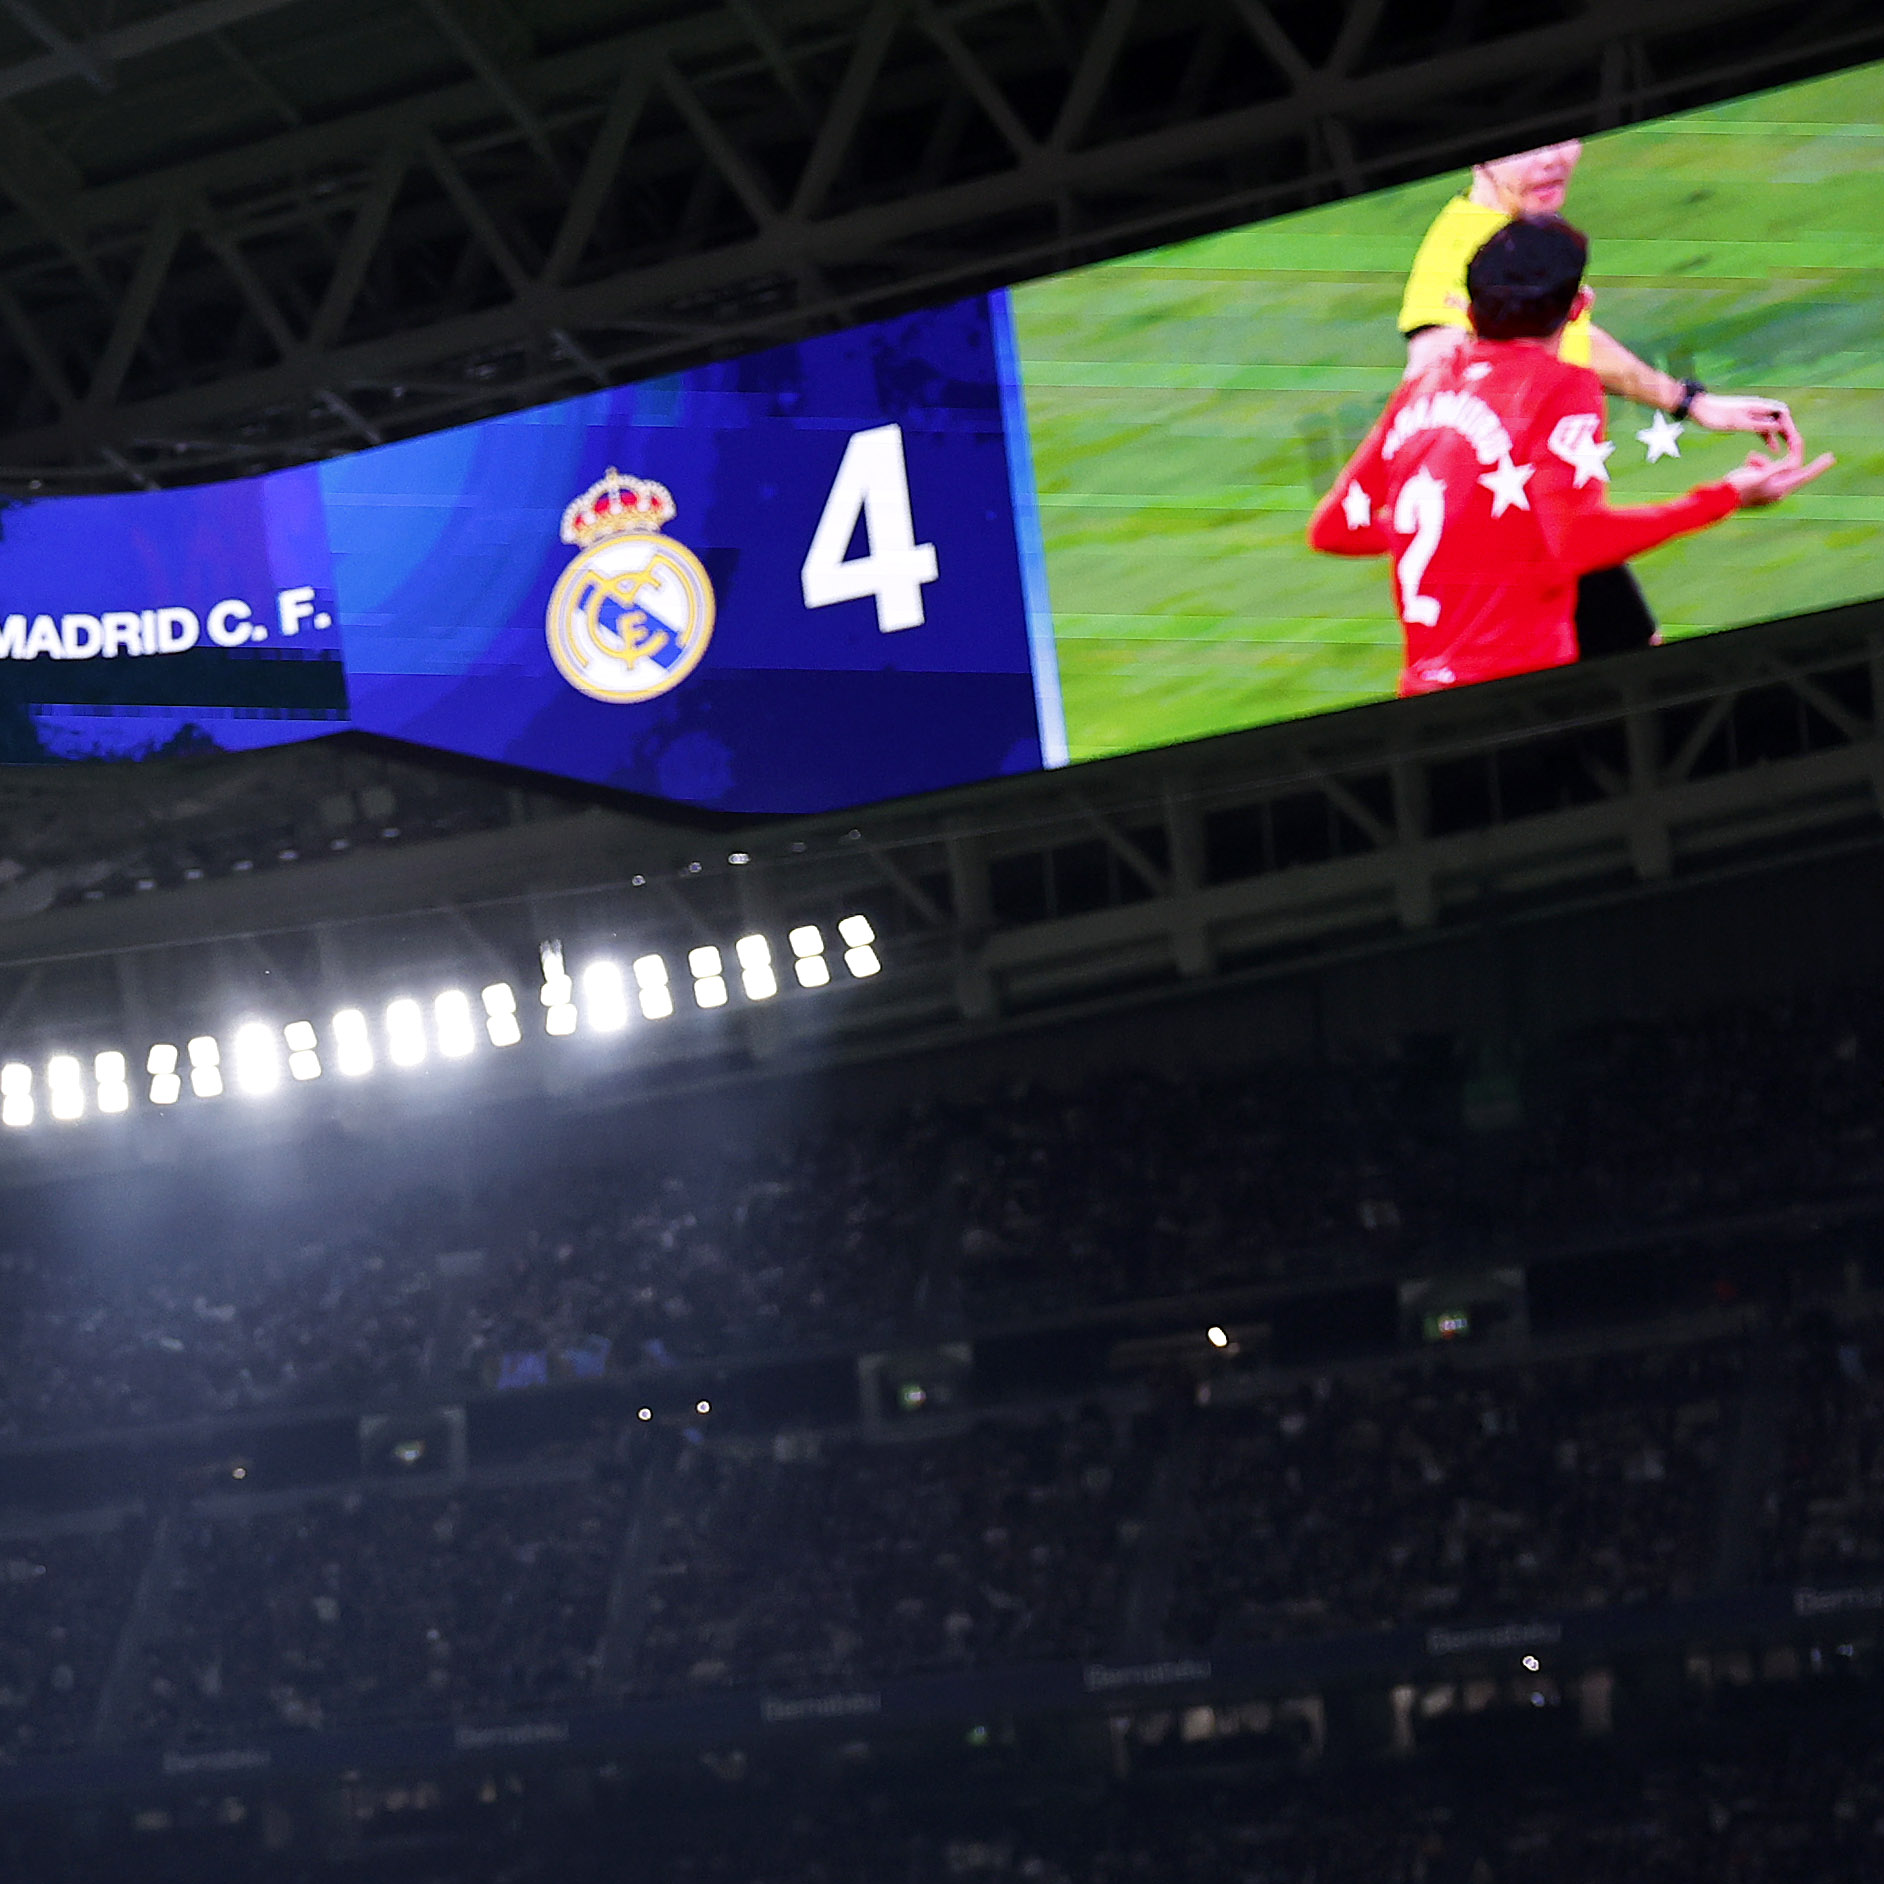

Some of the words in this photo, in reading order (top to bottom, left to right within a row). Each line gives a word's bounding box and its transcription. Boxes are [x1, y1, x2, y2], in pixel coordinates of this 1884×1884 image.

[801, 422, 940, 634] 4
[206, 599, 268, 647] C.
[277, 586, 333, 637] F.
